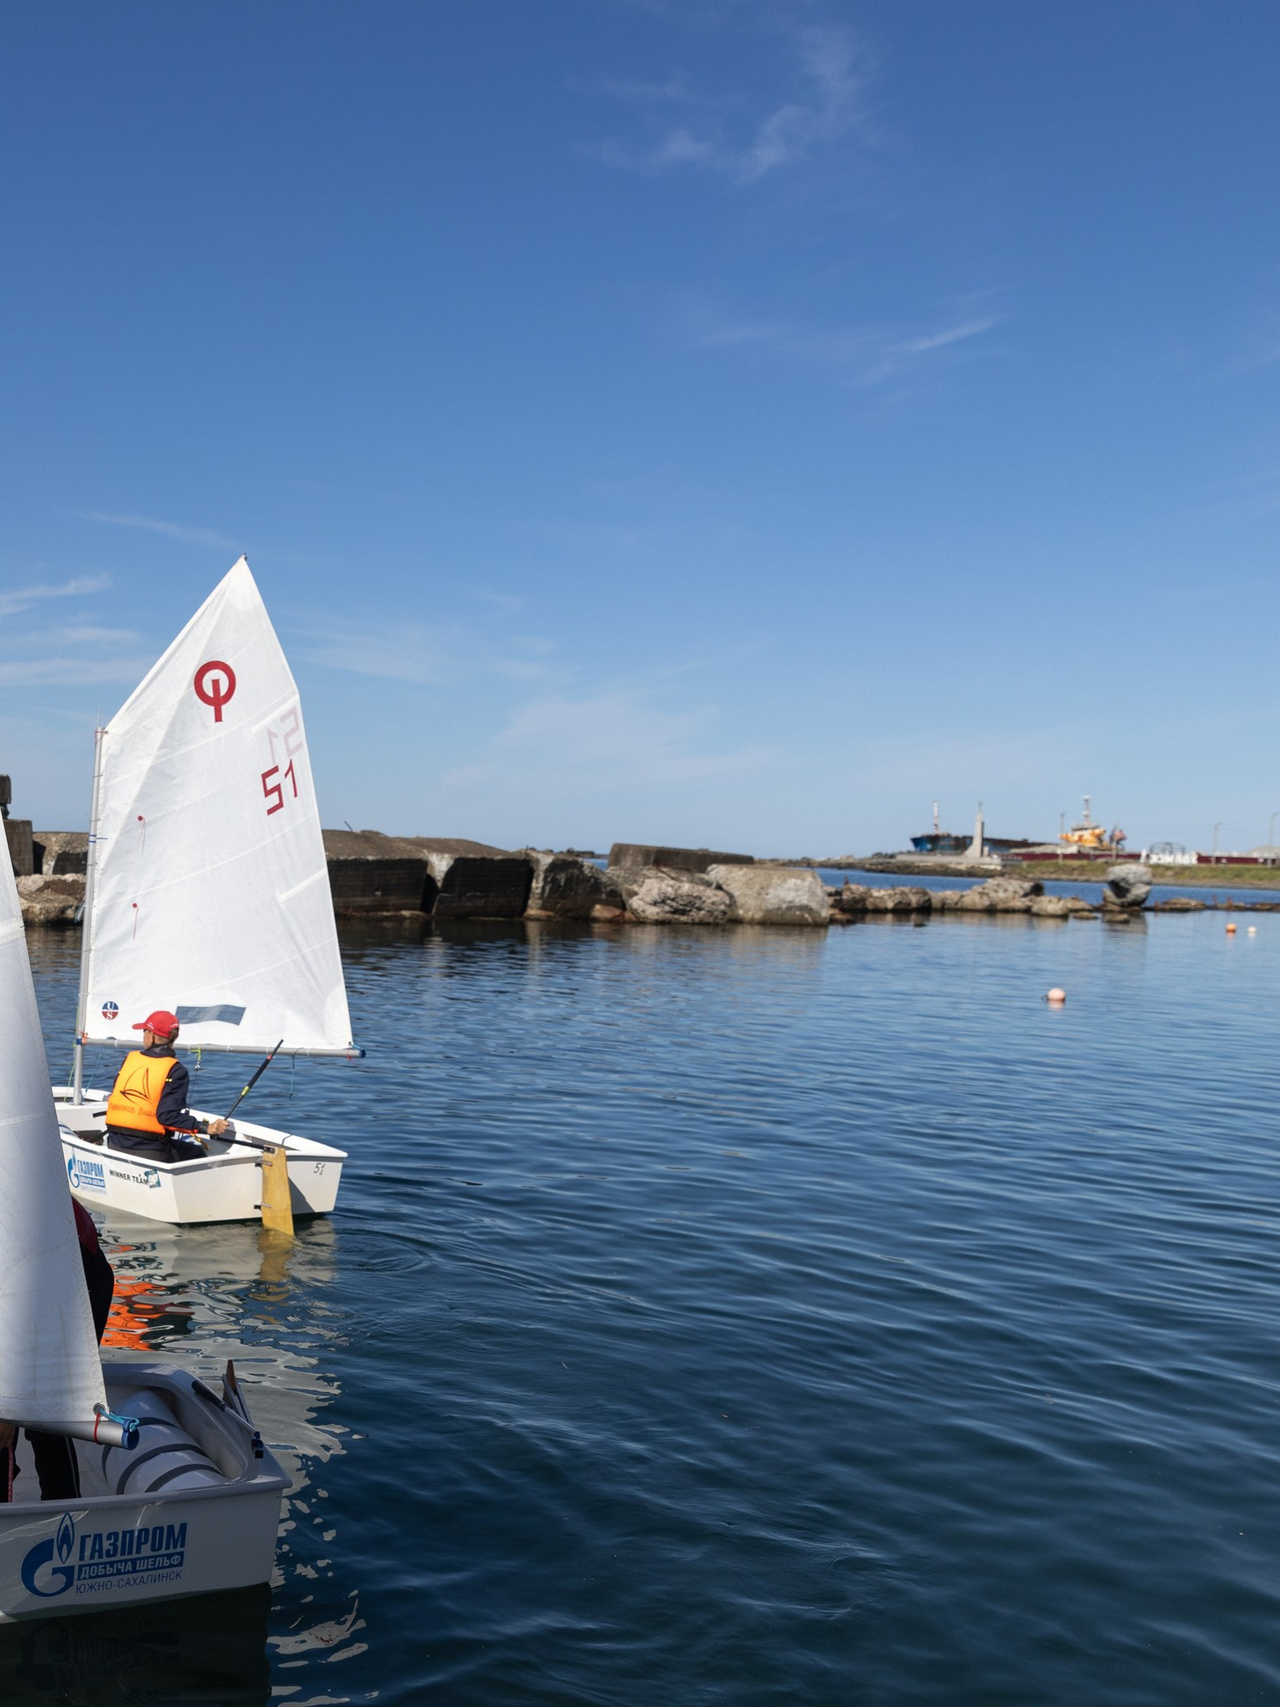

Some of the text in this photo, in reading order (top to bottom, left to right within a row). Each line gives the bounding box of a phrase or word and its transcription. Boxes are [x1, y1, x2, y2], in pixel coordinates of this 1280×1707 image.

[261, 758, 298, 816] 51
[77, 1159, 105, 1178] ГАЗПРОМ
[109, 1169, 149, 1185] WINNER TEAM
[78, 1522, 188, 1562] ГАЗПРОМ
[80, 1554, 181, 1580] ДОБЫЧА ШЕЛЬФ
[75, 1569, 183, 1594] ЮЖНО-САХАЛИНСК
